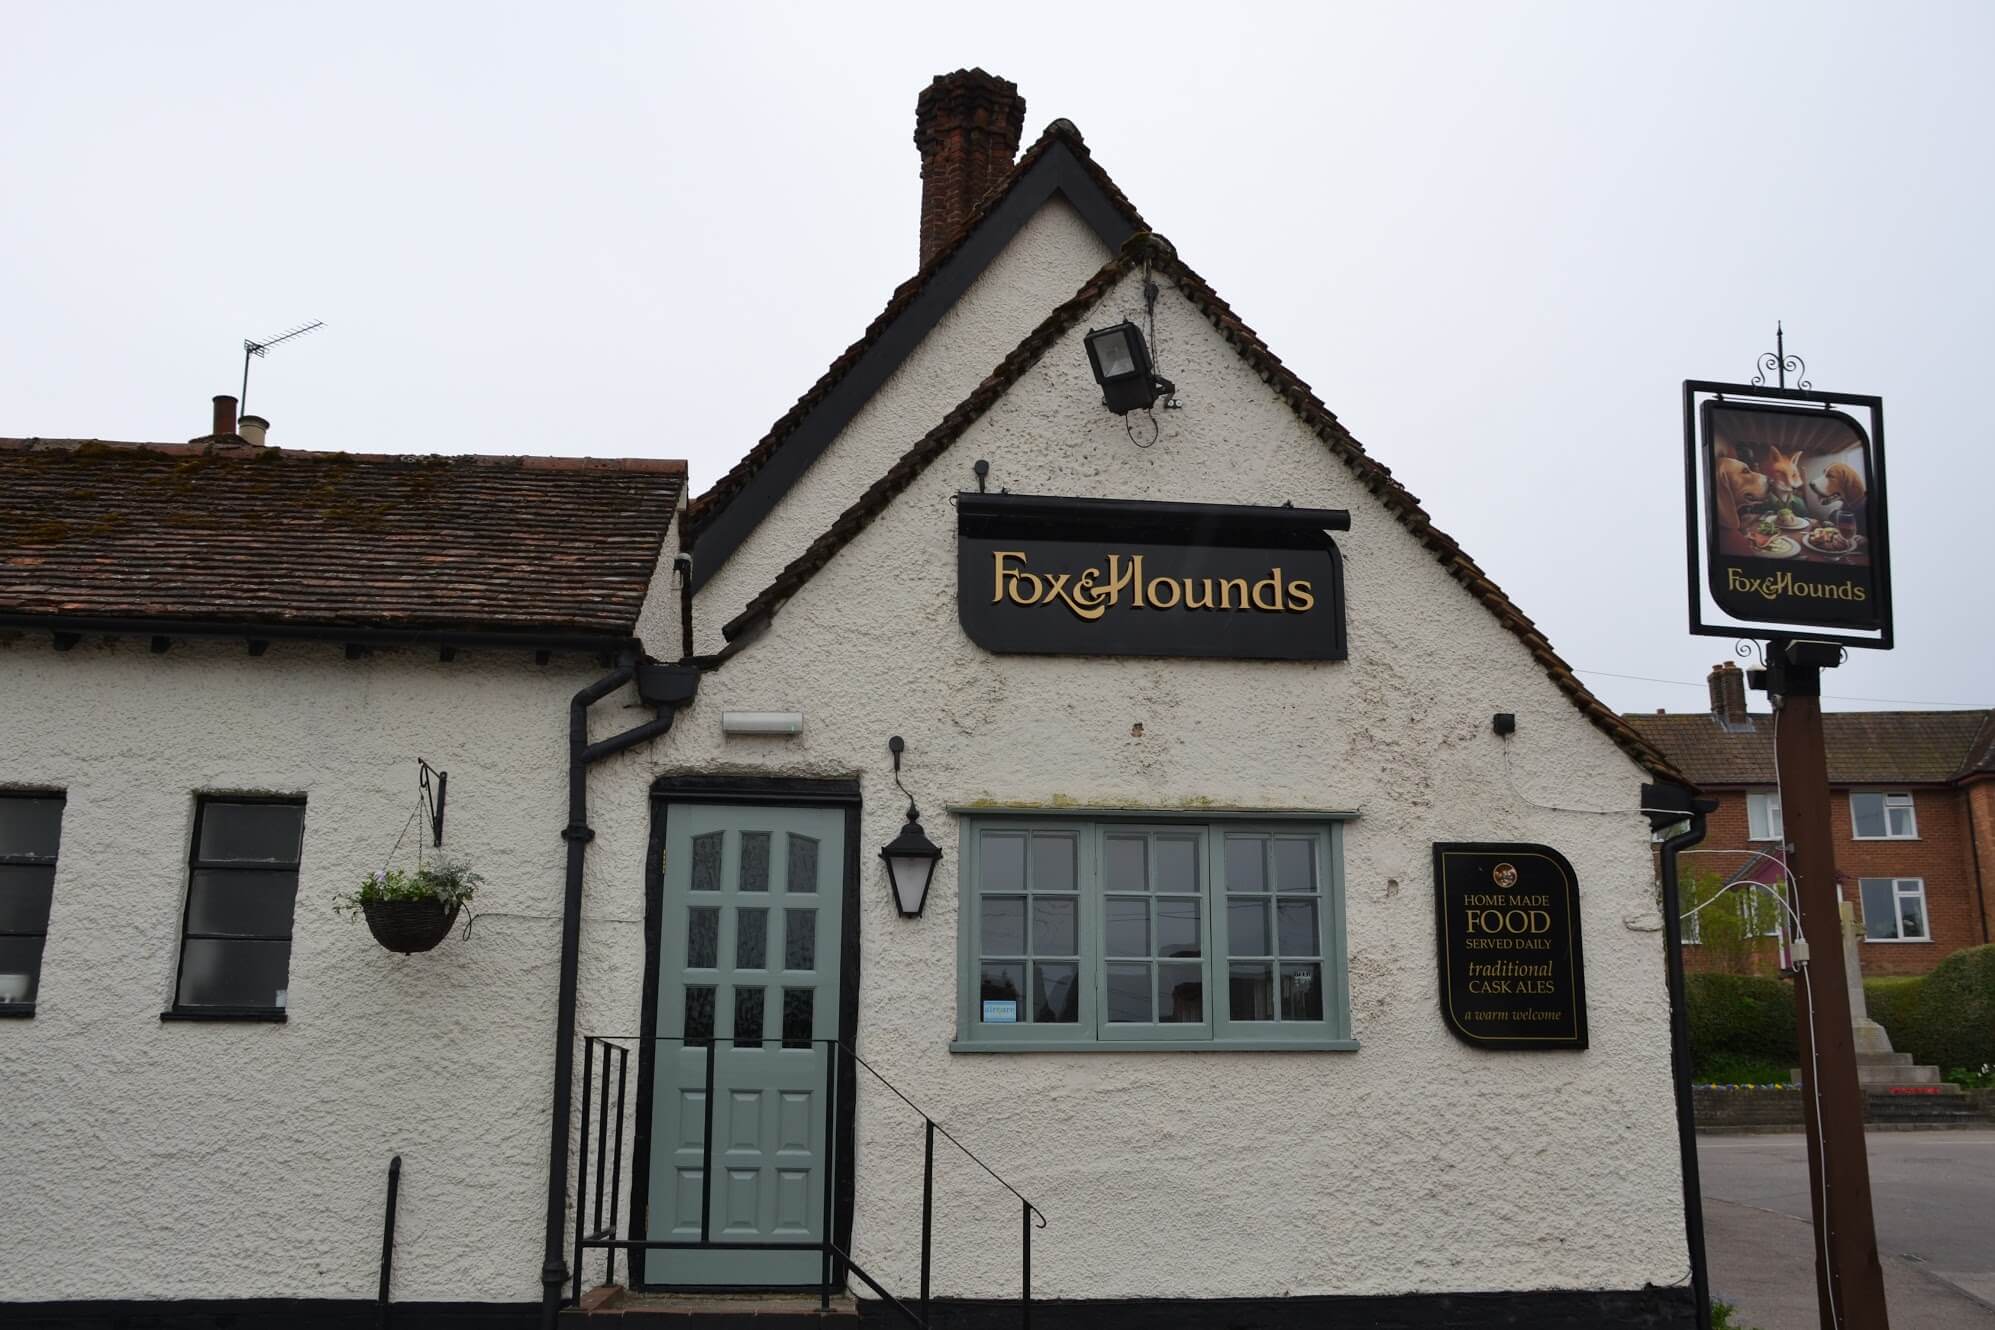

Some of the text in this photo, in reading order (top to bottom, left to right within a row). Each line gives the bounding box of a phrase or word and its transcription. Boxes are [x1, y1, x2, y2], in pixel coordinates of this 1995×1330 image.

[1464, 894, 1550, 906] HOME MADE
[1465, 909, 1551, 934] FOOD
[1465, 939, 1552, 950] SERVED DAILY
[1468, 960, 1553, 977] traditional
[1468, 980, 1555, 994] CASK ALES
[1464, 1007, 1562, 1021] a warm welcome
